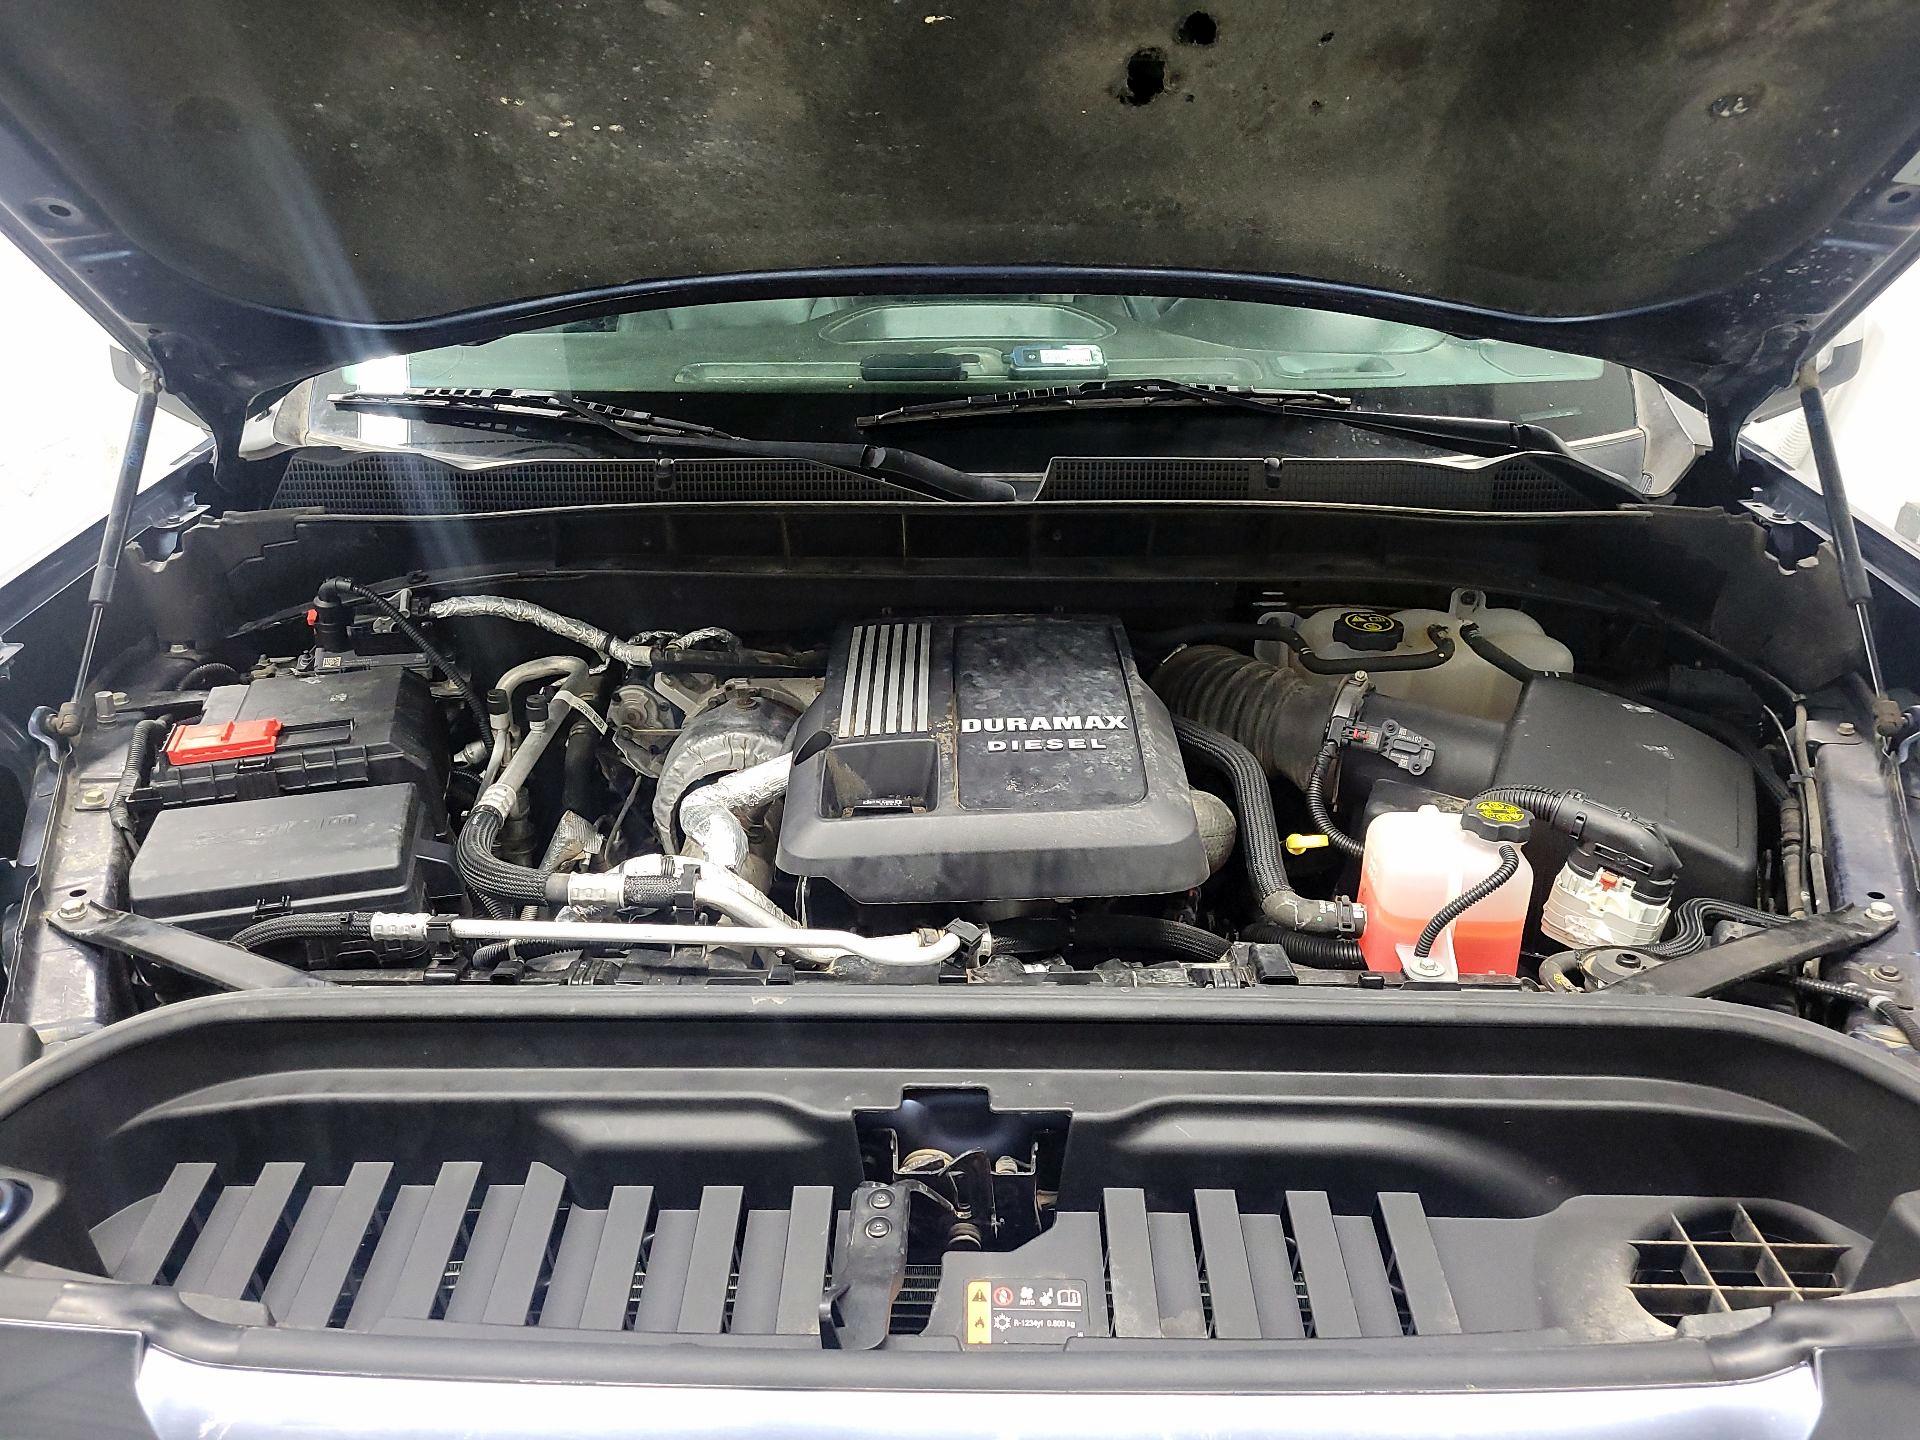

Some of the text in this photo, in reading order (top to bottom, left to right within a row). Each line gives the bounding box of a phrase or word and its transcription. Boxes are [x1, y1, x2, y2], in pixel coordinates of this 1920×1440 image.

[961, 715, 1129, 733] DURAMAX
[987, 738, 1107, 752] DIESEL
[1066, 1319, 1076, 1329] kg
